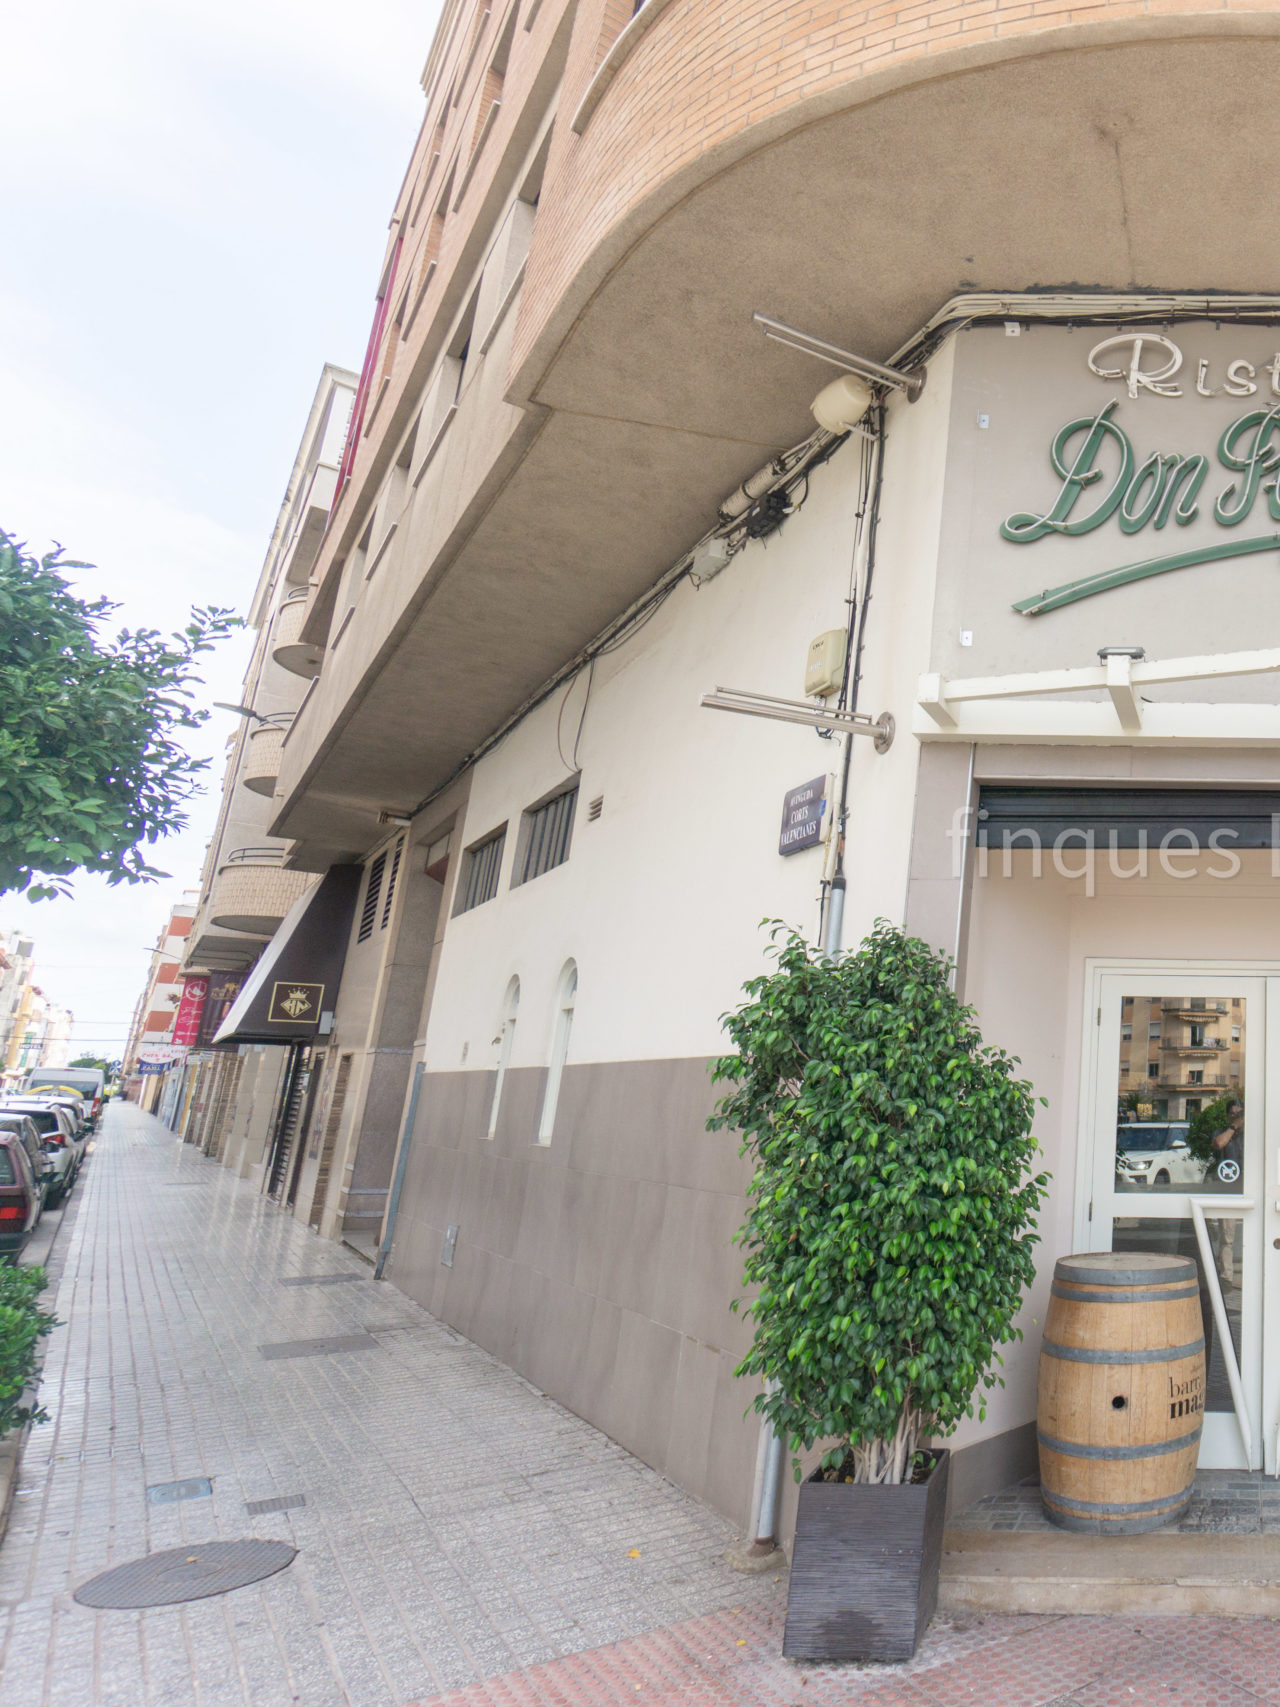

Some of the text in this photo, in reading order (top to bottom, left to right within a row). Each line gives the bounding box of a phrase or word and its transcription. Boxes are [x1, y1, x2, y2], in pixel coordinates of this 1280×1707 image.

[1000, 398, 1210, 543] Don
[790, 805, 809, 824] CORTS
[781, 820, 817, 845] VALENCIANES
